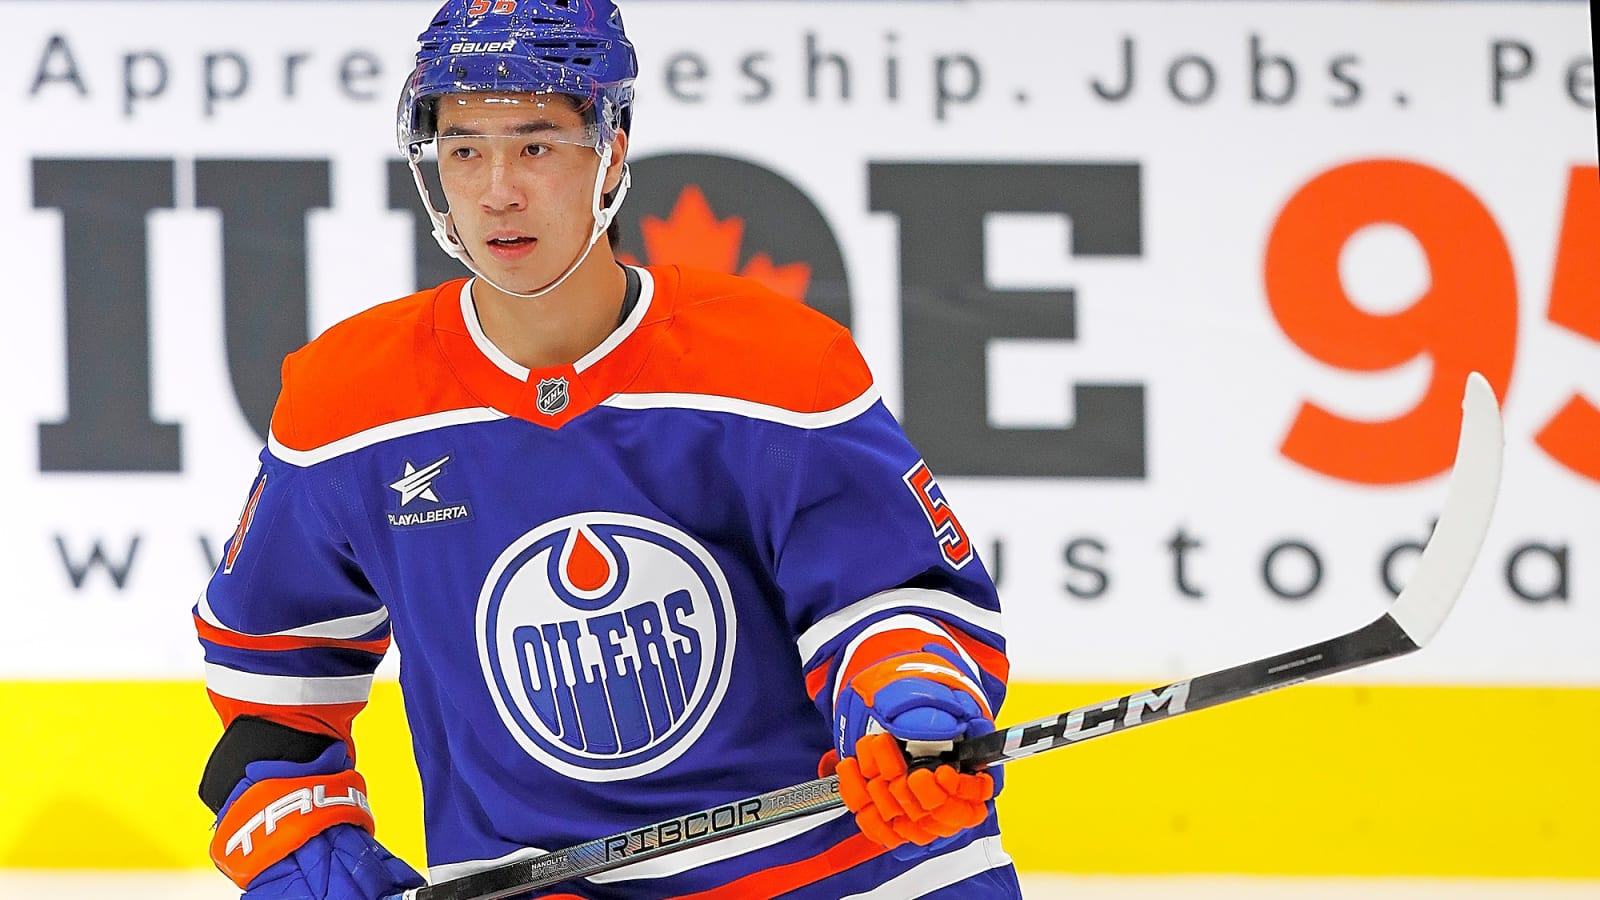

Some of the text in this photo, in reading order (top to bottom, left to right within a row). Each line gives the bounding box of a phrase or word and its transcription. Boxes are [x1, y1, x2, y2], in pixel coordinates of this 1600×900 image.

[1090, 34, 1407, 106] Jobs.
[544, 387, 563, 408] NHL
[512, 588, 702, 755] OILERS
[1002, 679, 1192, 757] CCM
[604, 798, 762, 862] RIBCOR
[768, 783, 831, 809] TRIGGER
